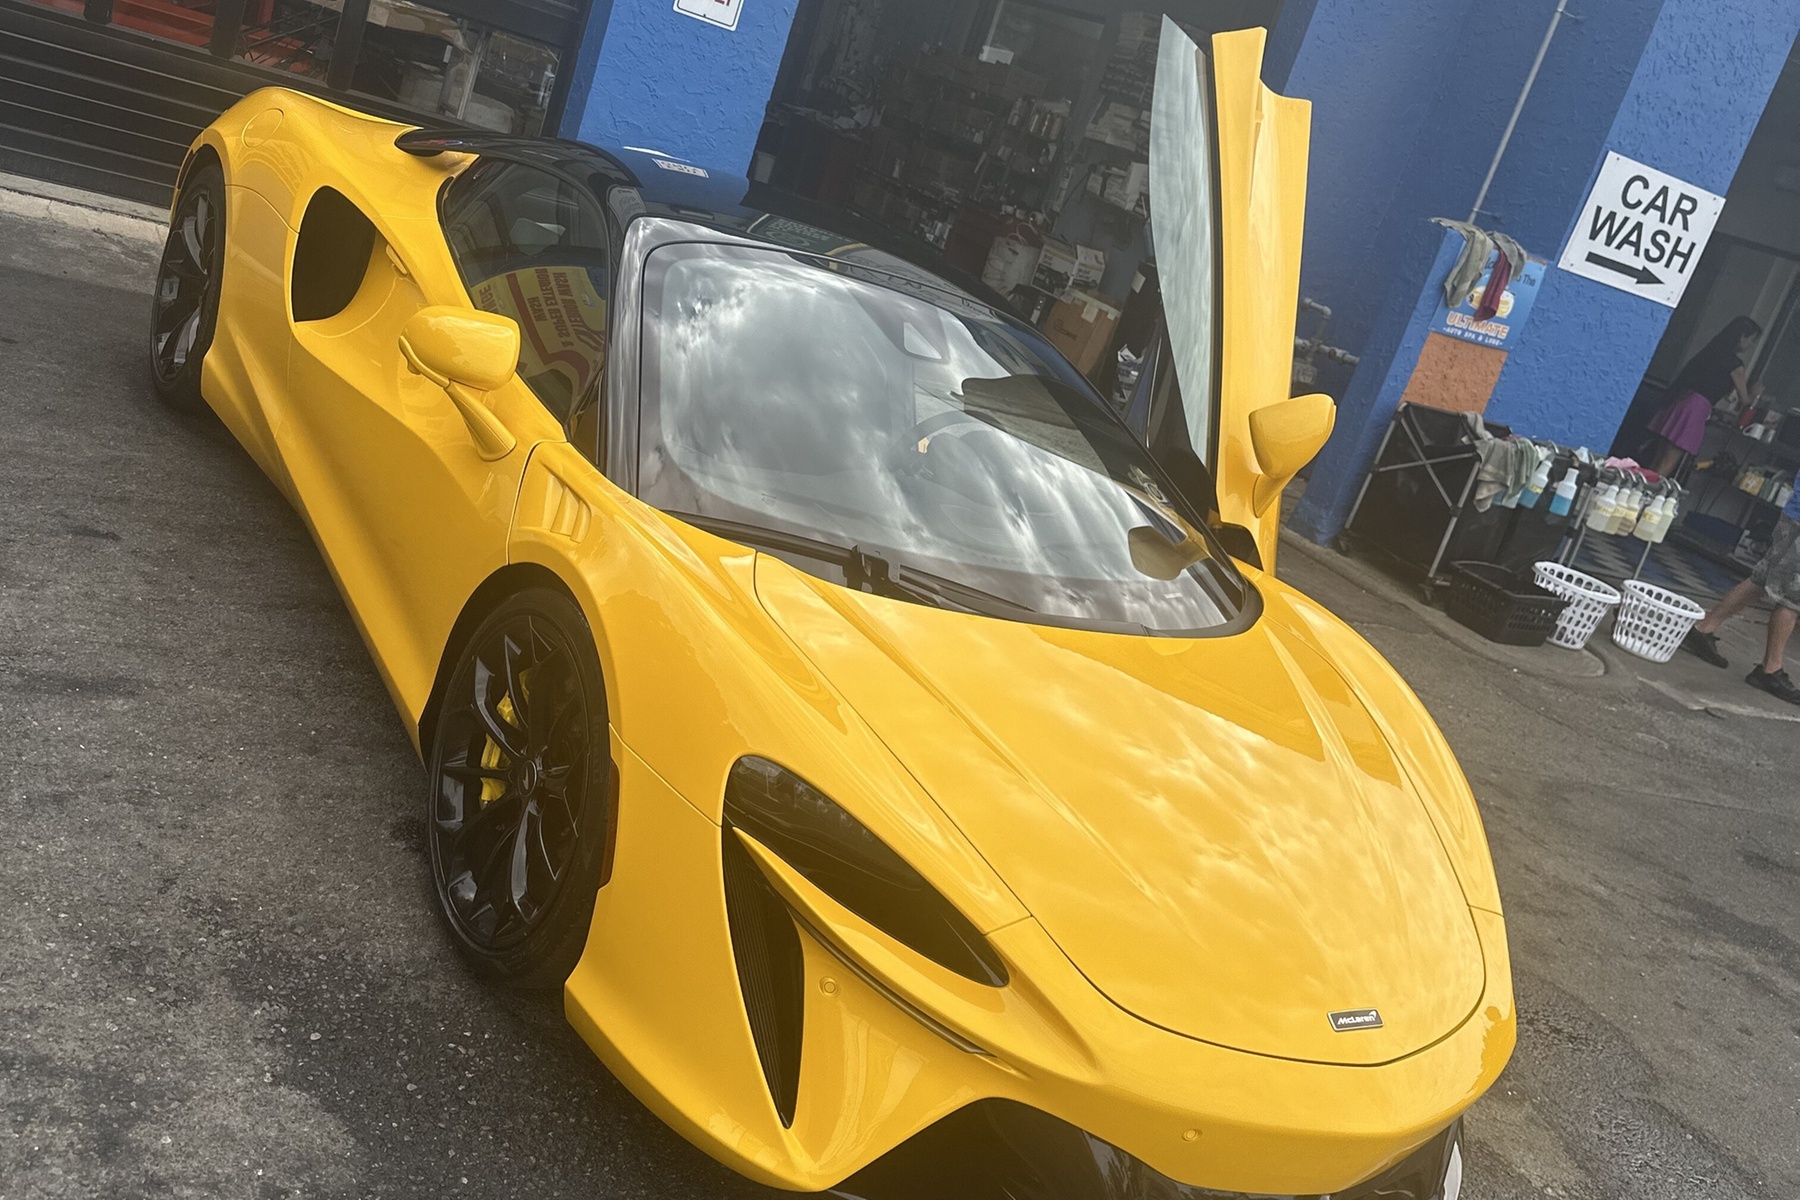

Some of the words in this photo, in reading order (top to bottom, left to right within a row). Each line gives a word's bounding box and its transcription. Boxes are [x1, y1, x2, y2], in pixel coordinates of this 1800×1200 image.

[1621, 174, 1698, 232] CAR
[1588, 205, 1697, 274] WASH
[1446, 311, 1510, 340] ULTIMATE
[1337, 1014, 1376, 1025] McLaren
